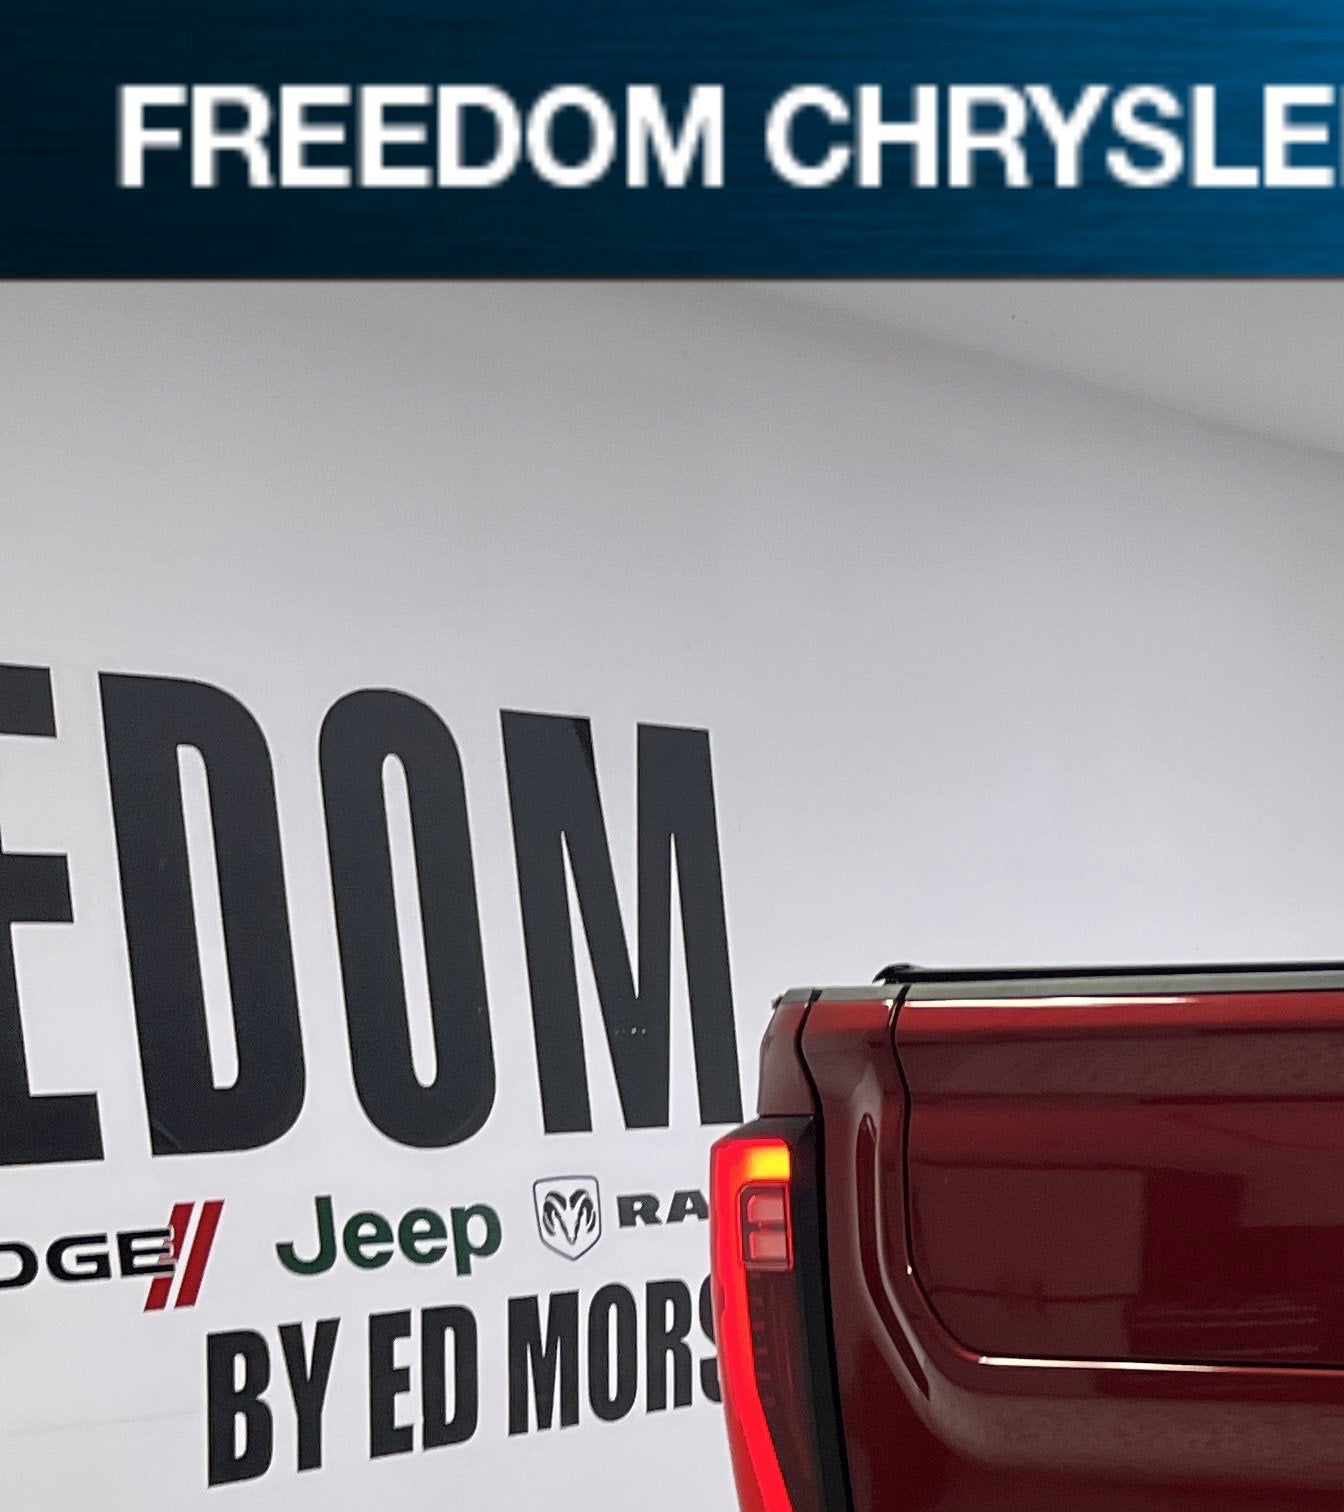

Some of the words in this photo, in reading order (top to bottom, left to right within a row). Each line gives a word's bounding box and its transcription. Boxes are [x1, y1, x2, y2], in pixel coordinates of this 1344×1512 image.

[276, 1196, 502, 1277] Jeep
[616, 1189, 710, 1228] RA
[207, 1316, 340, 1488] BY
[369, 1304, 478, 1460] ED
